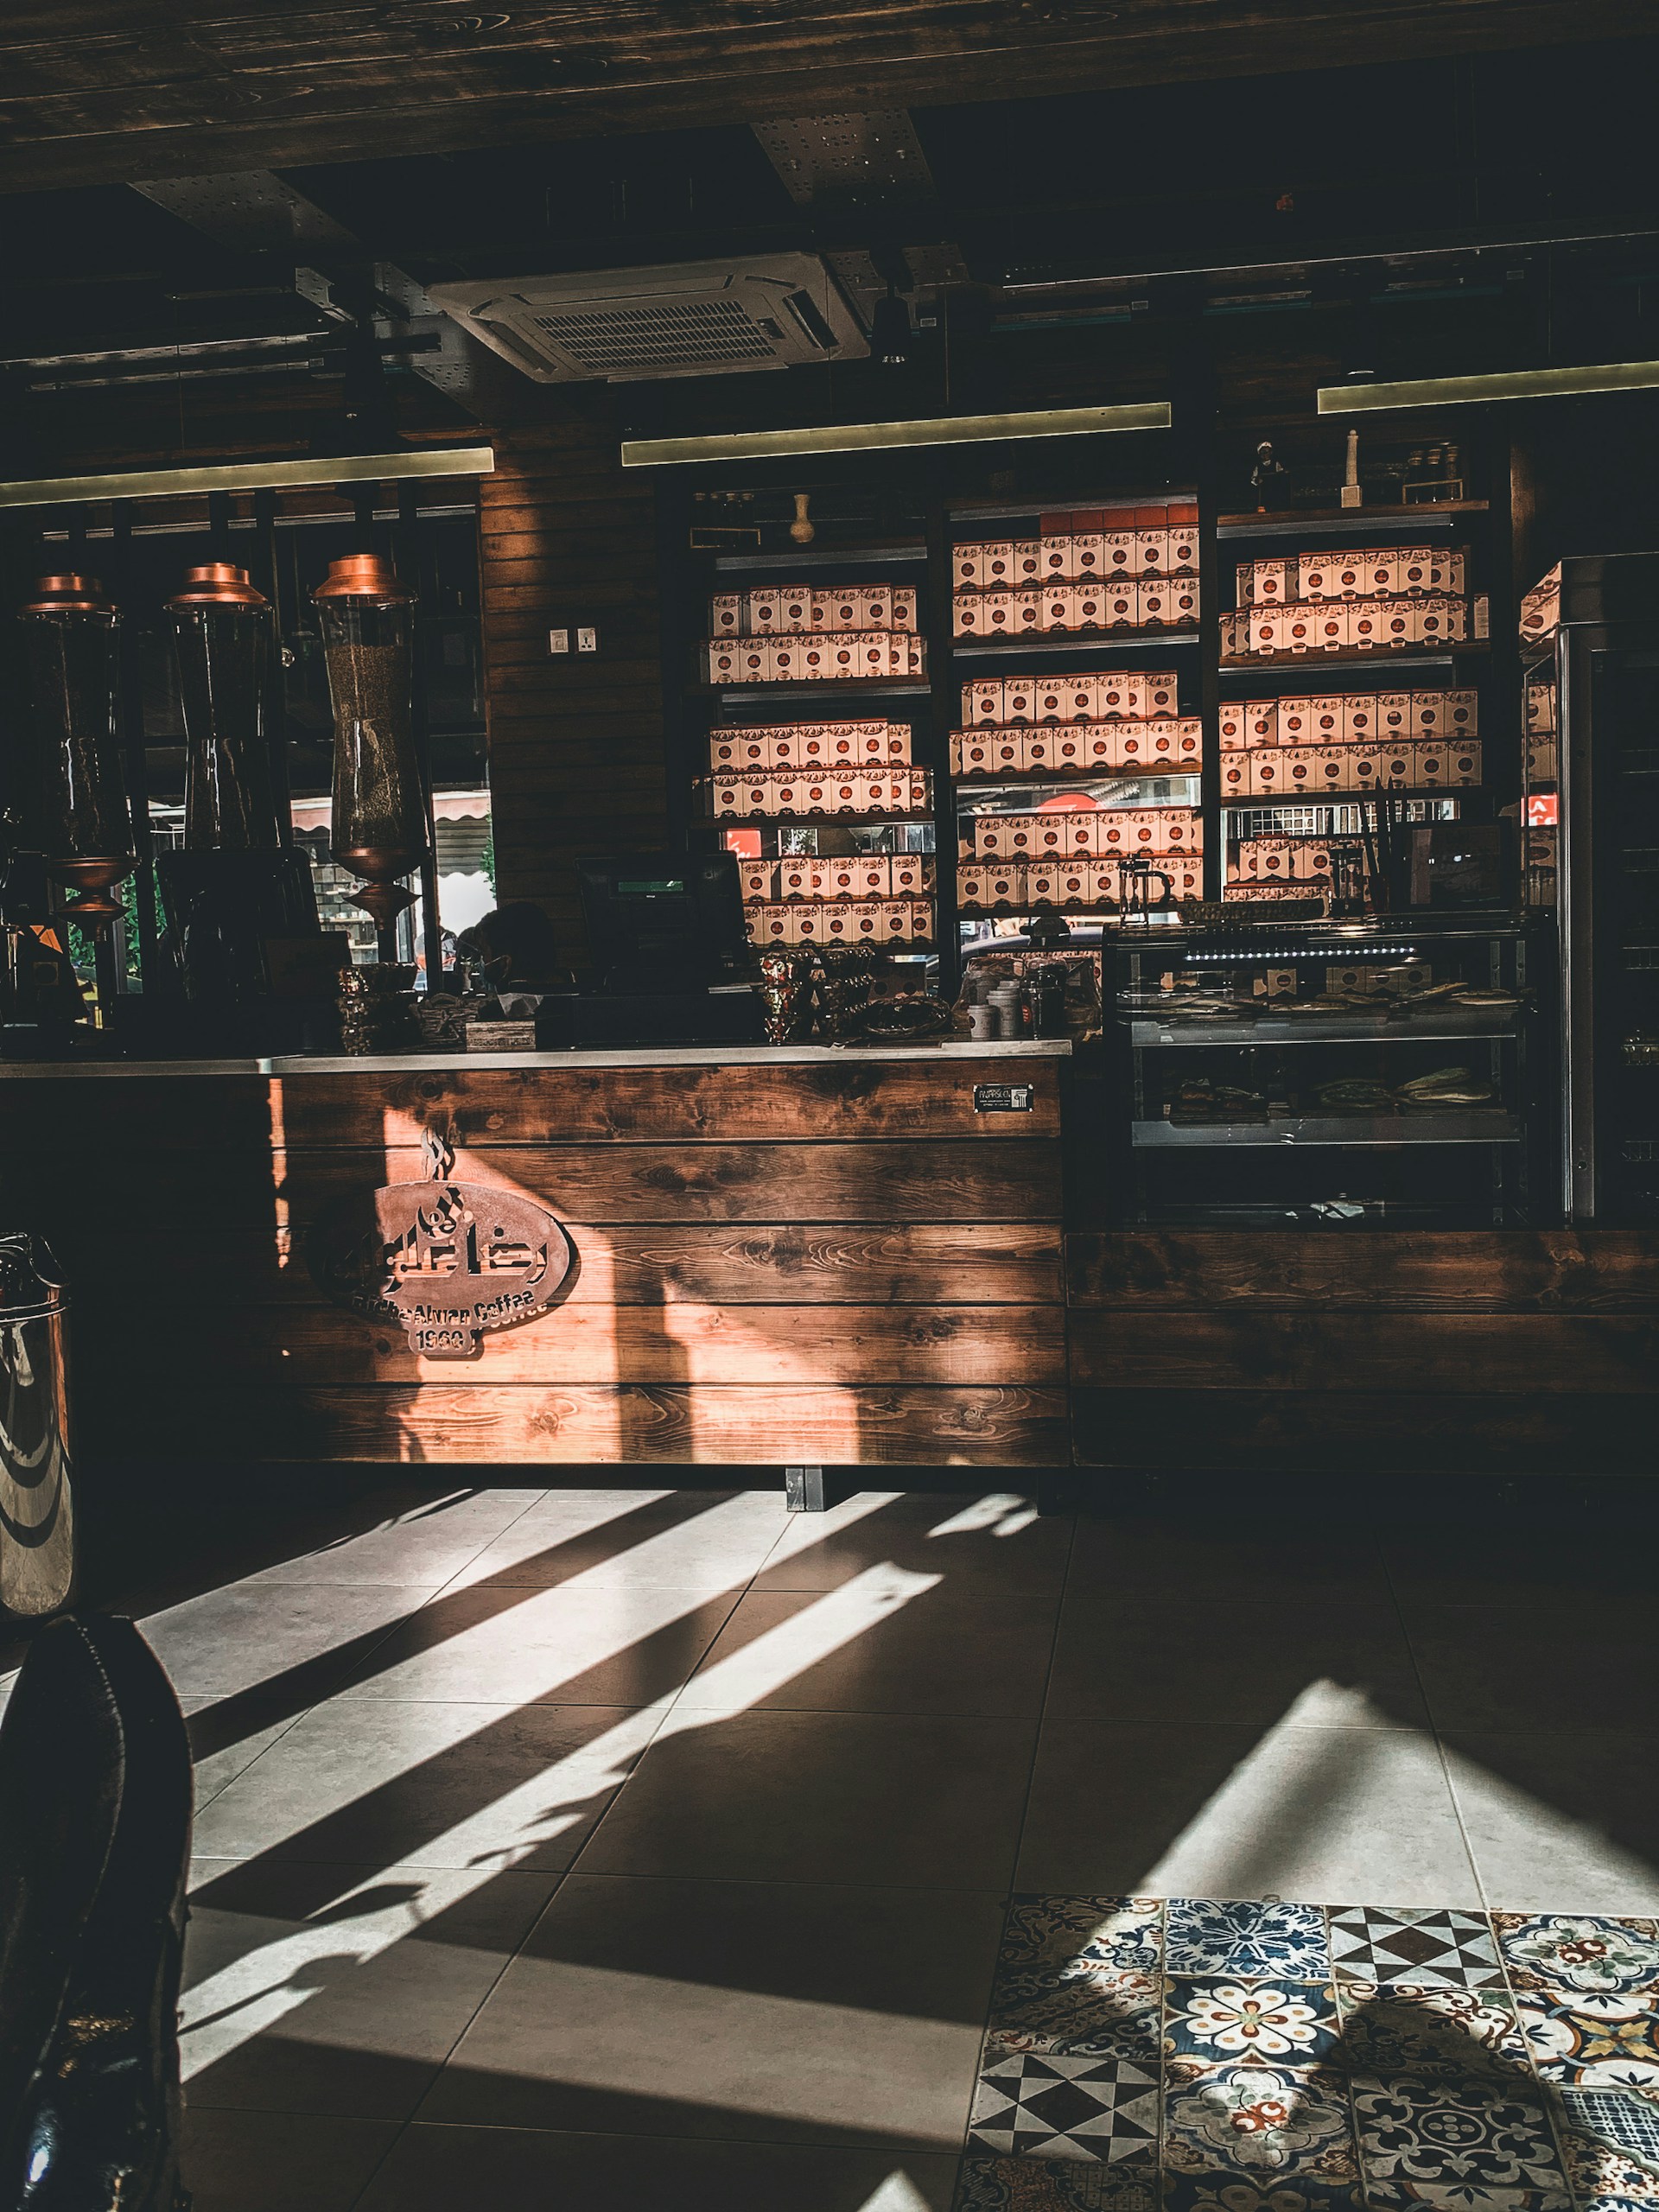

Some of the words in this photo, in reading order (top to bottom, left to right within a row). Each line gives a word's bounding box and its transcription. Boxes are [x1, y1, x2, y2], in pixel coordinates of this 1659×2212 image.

[467, 1223, 549, 1285] رضا
[415, 1304, 471, 1325] Alwan
[474, 1290, 536, 1323] Coffee
[416, 1329, 464, 1350] 1960
